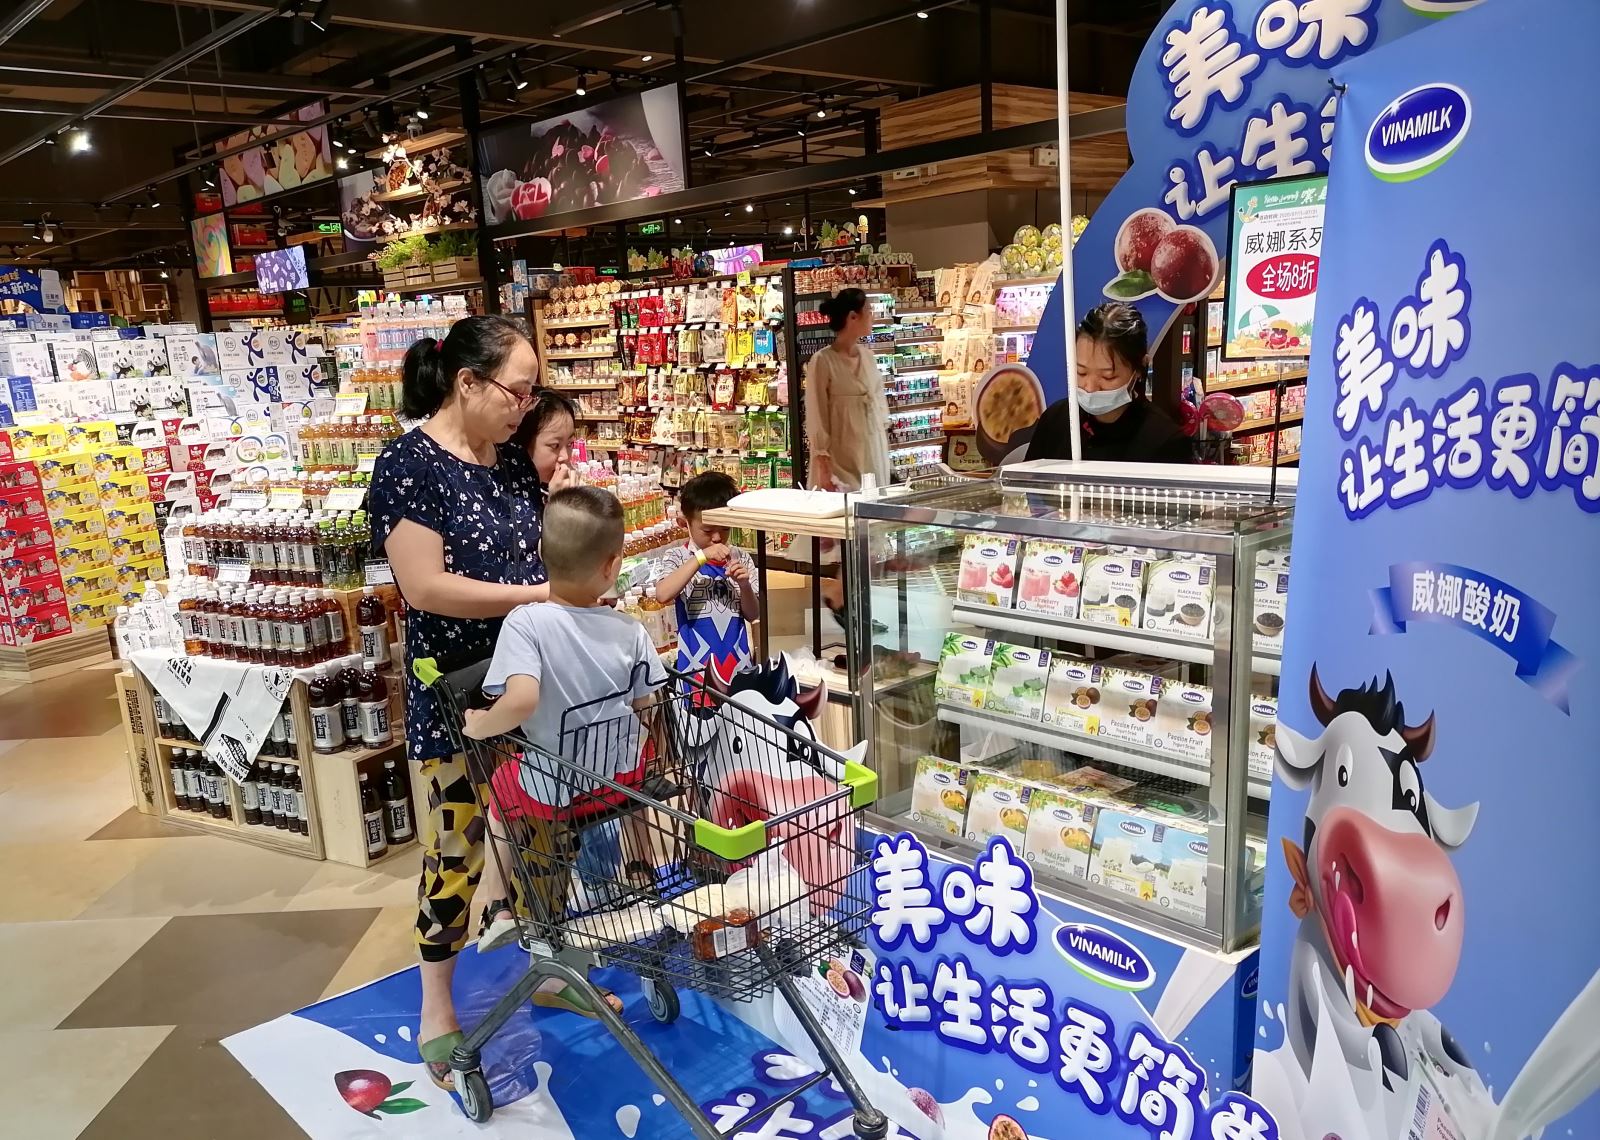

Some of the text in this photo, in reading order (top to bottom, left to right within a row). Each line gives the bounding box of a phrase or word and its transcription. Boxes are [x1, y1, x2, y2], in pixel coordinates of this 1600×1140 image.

[1163, 0, 1372, 129] 美味
[1381, 105, 1453, 147] VINAMILK
[1262, 259, 1315, 293] 全场8折
[1337, 249, 1464, 432] 美味
[1044, 556, 1063, 564] VINAMILK
[1103, 564, 1124, 573] VINAMILK
[1169, 572, 1191, 581] VINAMILK
[1412, 570, 1521, 643] 威娜酸奶
[1066, 670, 1086, 679] VINAMILK
[1123, 681, 1145, 690] VINAMILK
[1181, 693, 1205, 702] VINAMILK
[1254, 706, 1277, 715] VINAMILK
[1111, 719, 1145, 732] Passion Fruit
[1167, 732, 1204, 747] Passion Fruit
[1121, 822, 1145, 835] VINAMILK
[1190, 843, 1208, 853] VINAM
[872, 838, 1031, 947] 美味
[1069, 933, 1137, 974] VINAMILK
